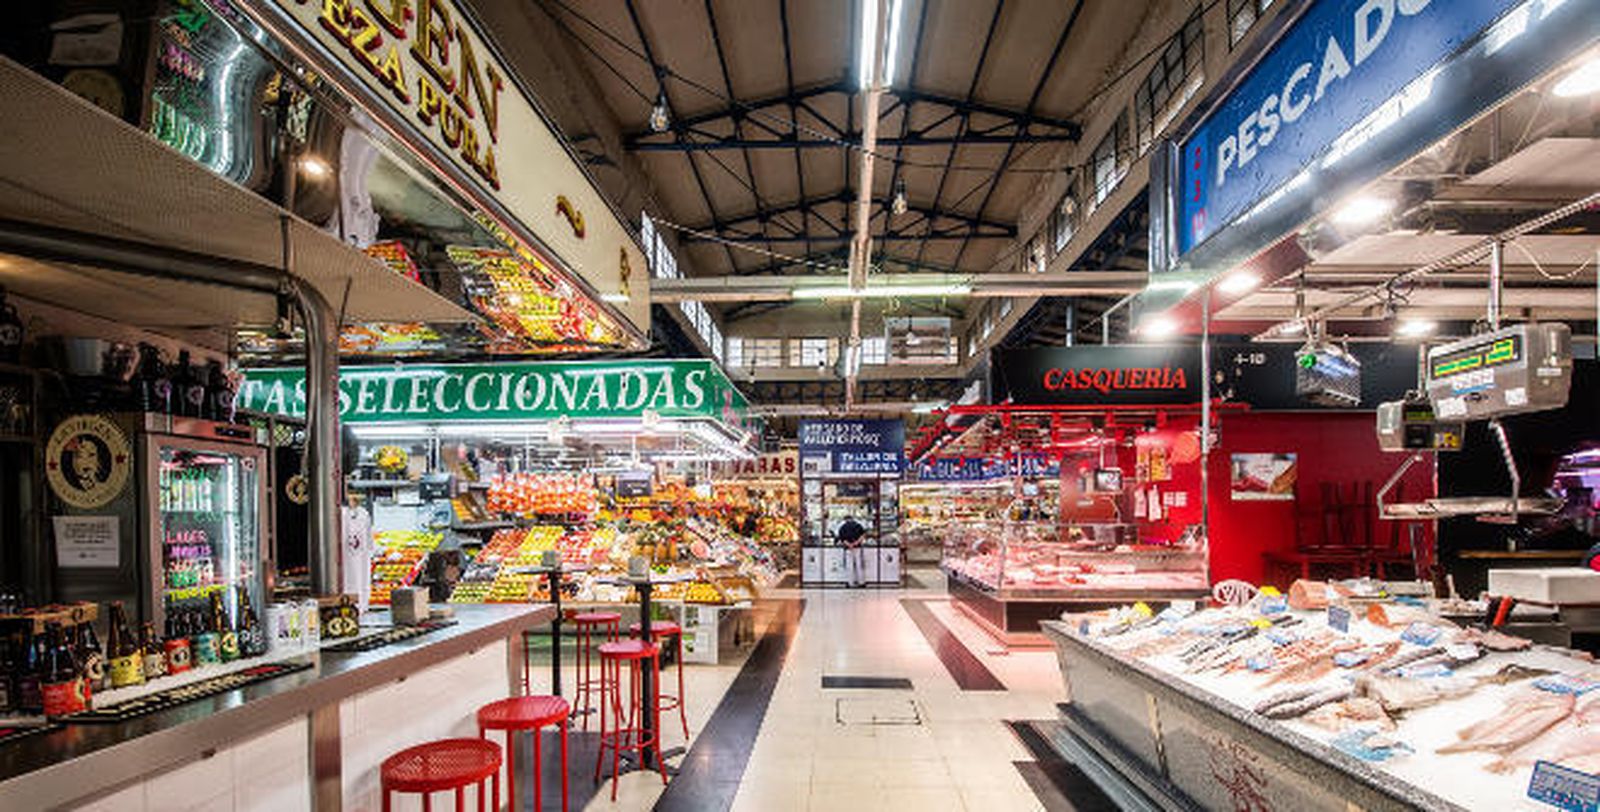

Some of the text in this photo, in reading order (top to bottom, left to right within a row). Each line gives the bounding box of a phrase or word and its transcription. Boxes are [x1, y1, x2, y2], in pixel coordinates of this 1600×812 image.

[296, 0, 411, 104] EZA
[417, 75, 500, 190] PURA
[1216, 0, 1433, 187] PESCADO
[338, 369, 707, 415] SELECCIONADAS
